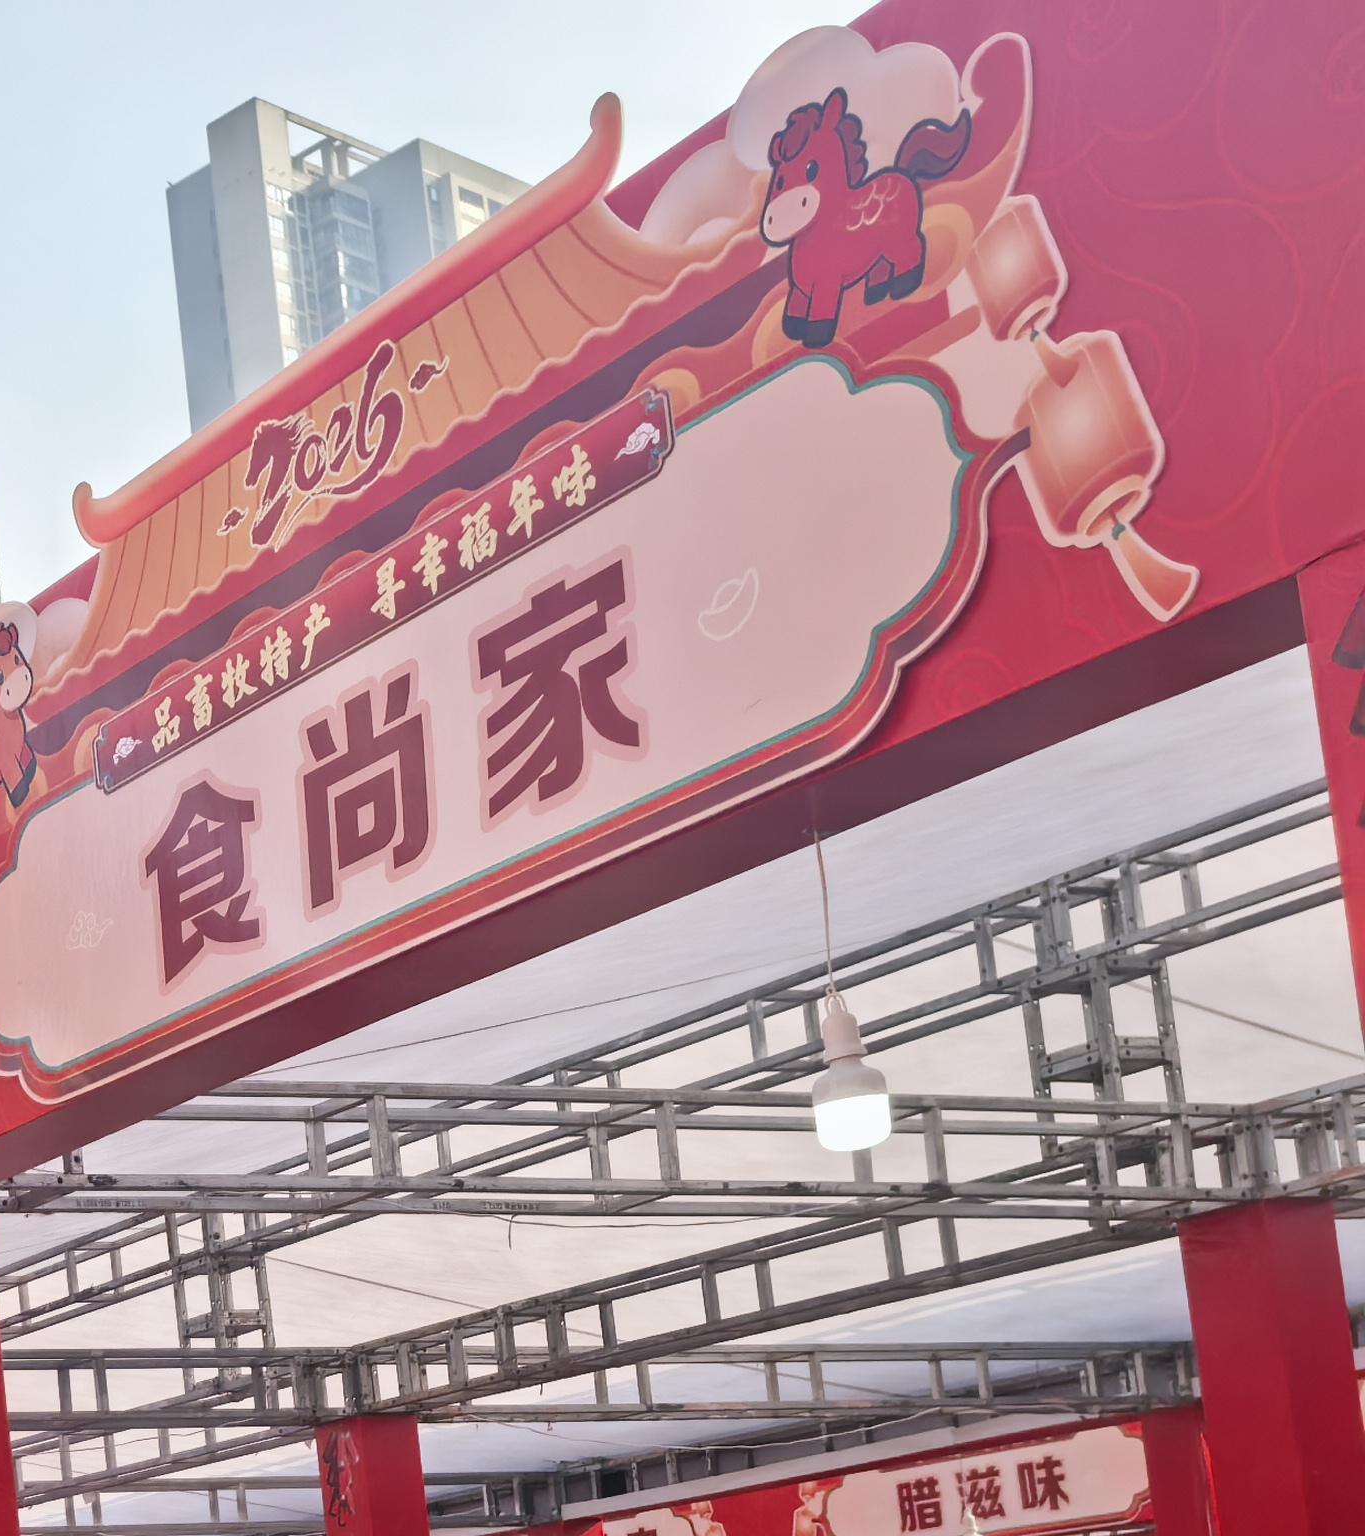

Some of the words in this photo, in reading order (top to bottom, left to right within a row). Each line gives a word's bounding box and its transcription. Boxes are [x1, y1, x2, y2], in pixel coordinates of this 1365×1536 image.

[243, 343, 409, 548] 2026
[150, 602, 335, 752] 品畜牧特产
[371, 446, 600, 622] 寻幸福年味
[143, 558, 643, 986] 食尚家
[896, 1455, 1071, 1534] 腊滋味
